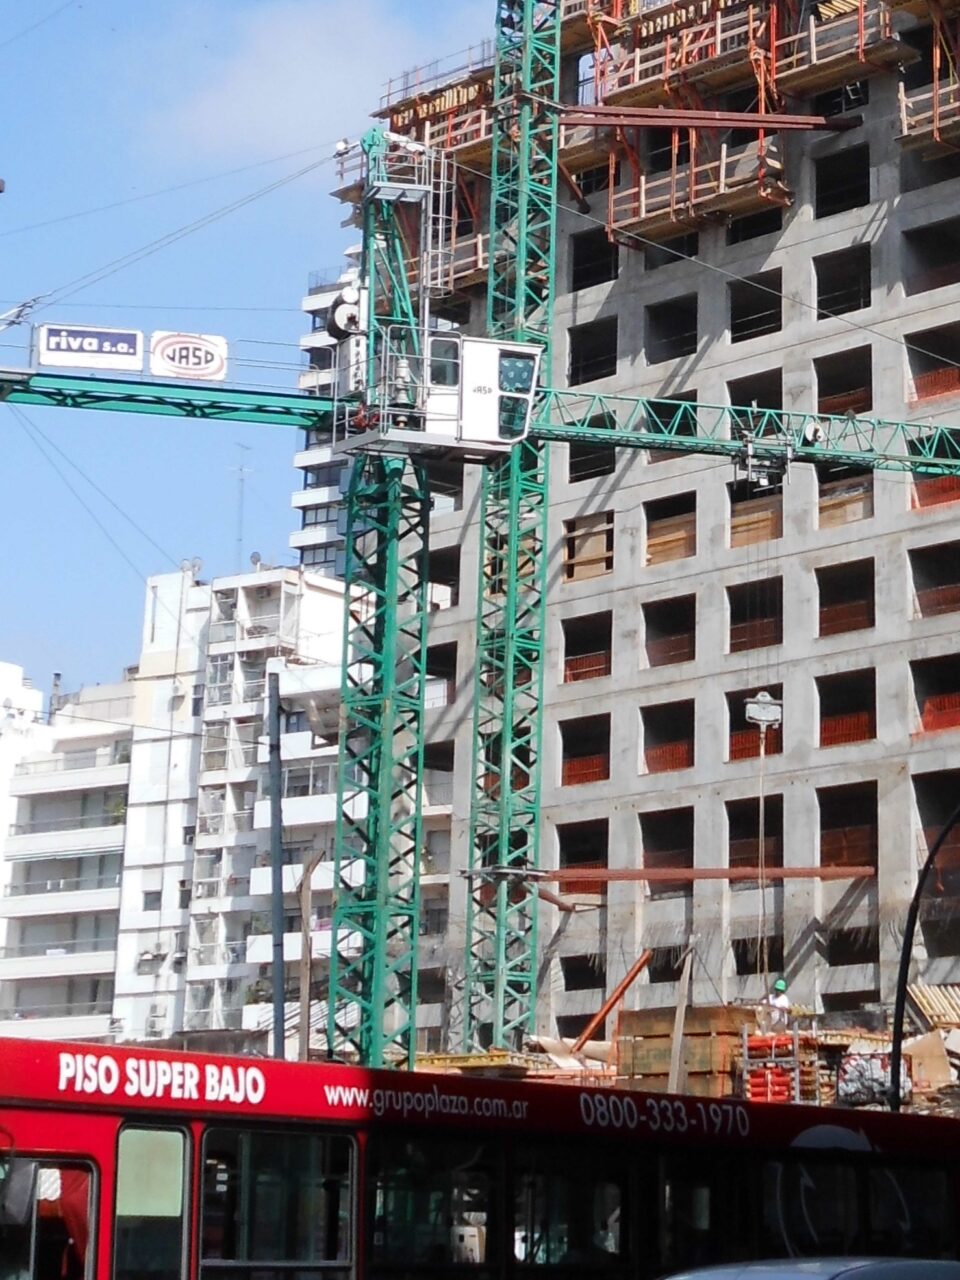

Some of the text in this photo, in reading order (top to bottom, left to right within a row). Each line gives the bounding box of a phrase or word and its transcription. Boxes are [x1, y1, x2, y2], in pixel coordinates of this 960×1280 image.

[49, 331, 134, 353] riva s.a.
[58, 1052, 265, 1104] PISO SUPER BAJO
[323, 1084, 529, 1119] www.grupoplaza.com.ar
[579, 1092, 749, 1136] 0800-333-1970
